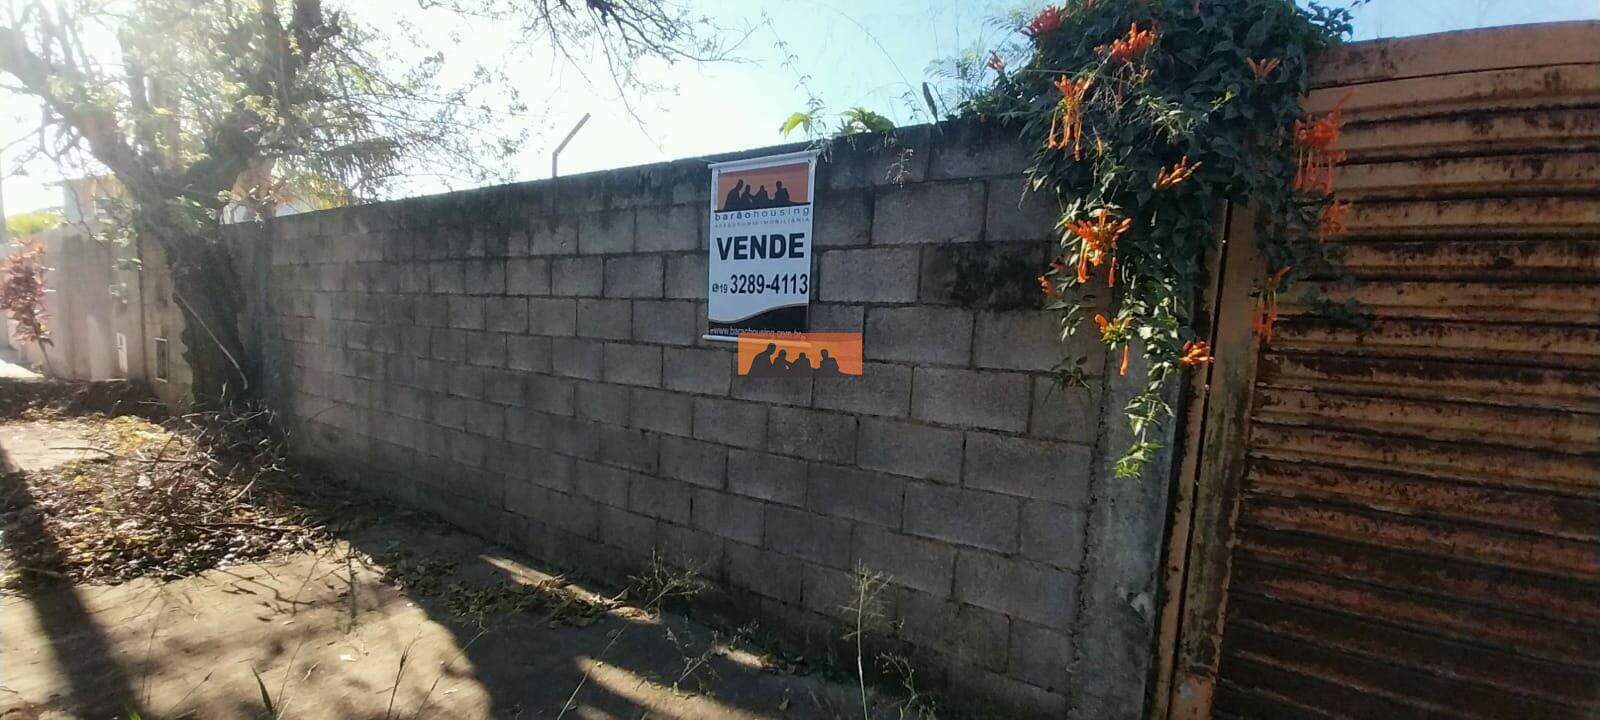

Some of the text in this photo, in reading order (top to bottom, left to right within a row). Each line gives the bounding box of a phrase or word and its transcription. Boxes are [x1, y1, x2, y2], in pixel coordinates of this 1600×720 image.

[716, 232, 805, 261] VENDE
[720, 273, 808, 294] 19 3289-4113
